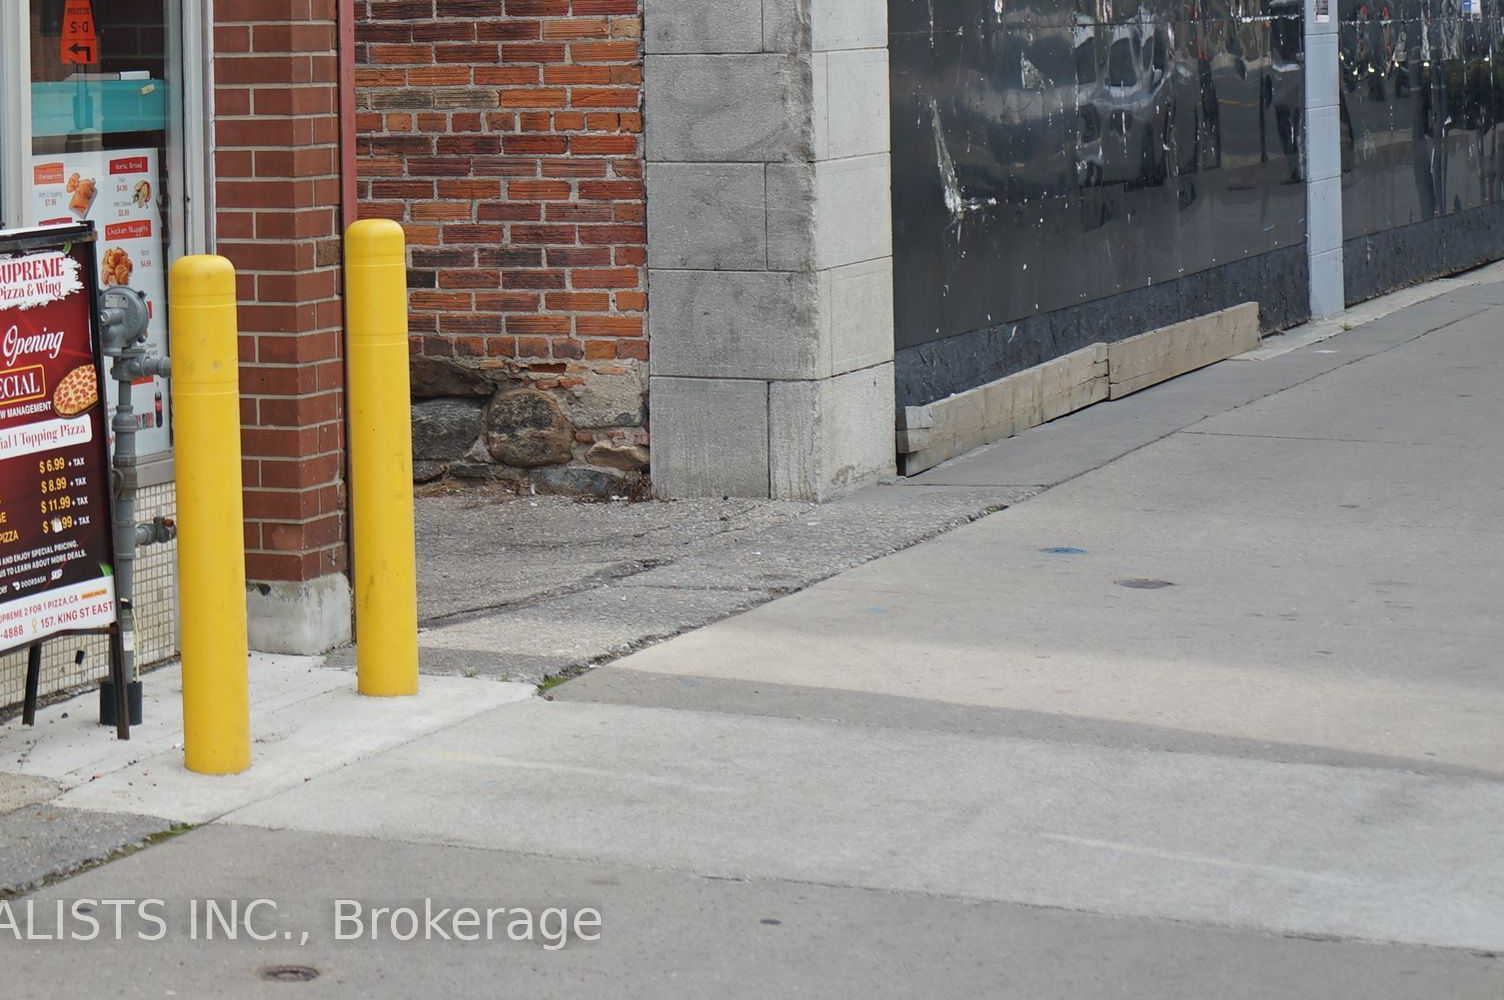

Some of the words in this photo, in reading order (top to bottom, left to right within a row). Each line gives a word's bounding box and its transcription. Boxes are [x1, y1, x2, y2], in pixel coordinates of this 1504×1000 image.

[26, 283, 34, 296] &
[36, 280, 62, 298] Wing
[3, 325, 64, 367] Opening
[7, 401, 52, 421] MANAGEMENT
[19, 428, 58, 448] Topping
[59, 422, 86, 437] Pizza
[73, 457, 85, 467] TAX
[74, 477, 87, 487] TAX
[76, 496, 88, 506] TAX
[78, 516, 90, 526] TAX
[0, 569, 7, 577] US
[7, 567, 14, 576] TO
[14, 562, 32, 574] LEARN
[32, 558, 50, 570] ABOUT
[51, 554, 67, 565] MORE
[67, 549, 87, 561] DEALS.
[2, 555, 13, 566] AND
[13, 551, 31, 563] ENJOY
[31, 546, 53, 559] SPECIAL
[20, 575, 47, 589] DOORDASH
[24, 607, 29, 616] 2
[29, 603, 42, 614] FOR
[57, 610, 78, 625] KING
[79, 607, 90, 618] ST
[91, 601, 114, 615] EAST
